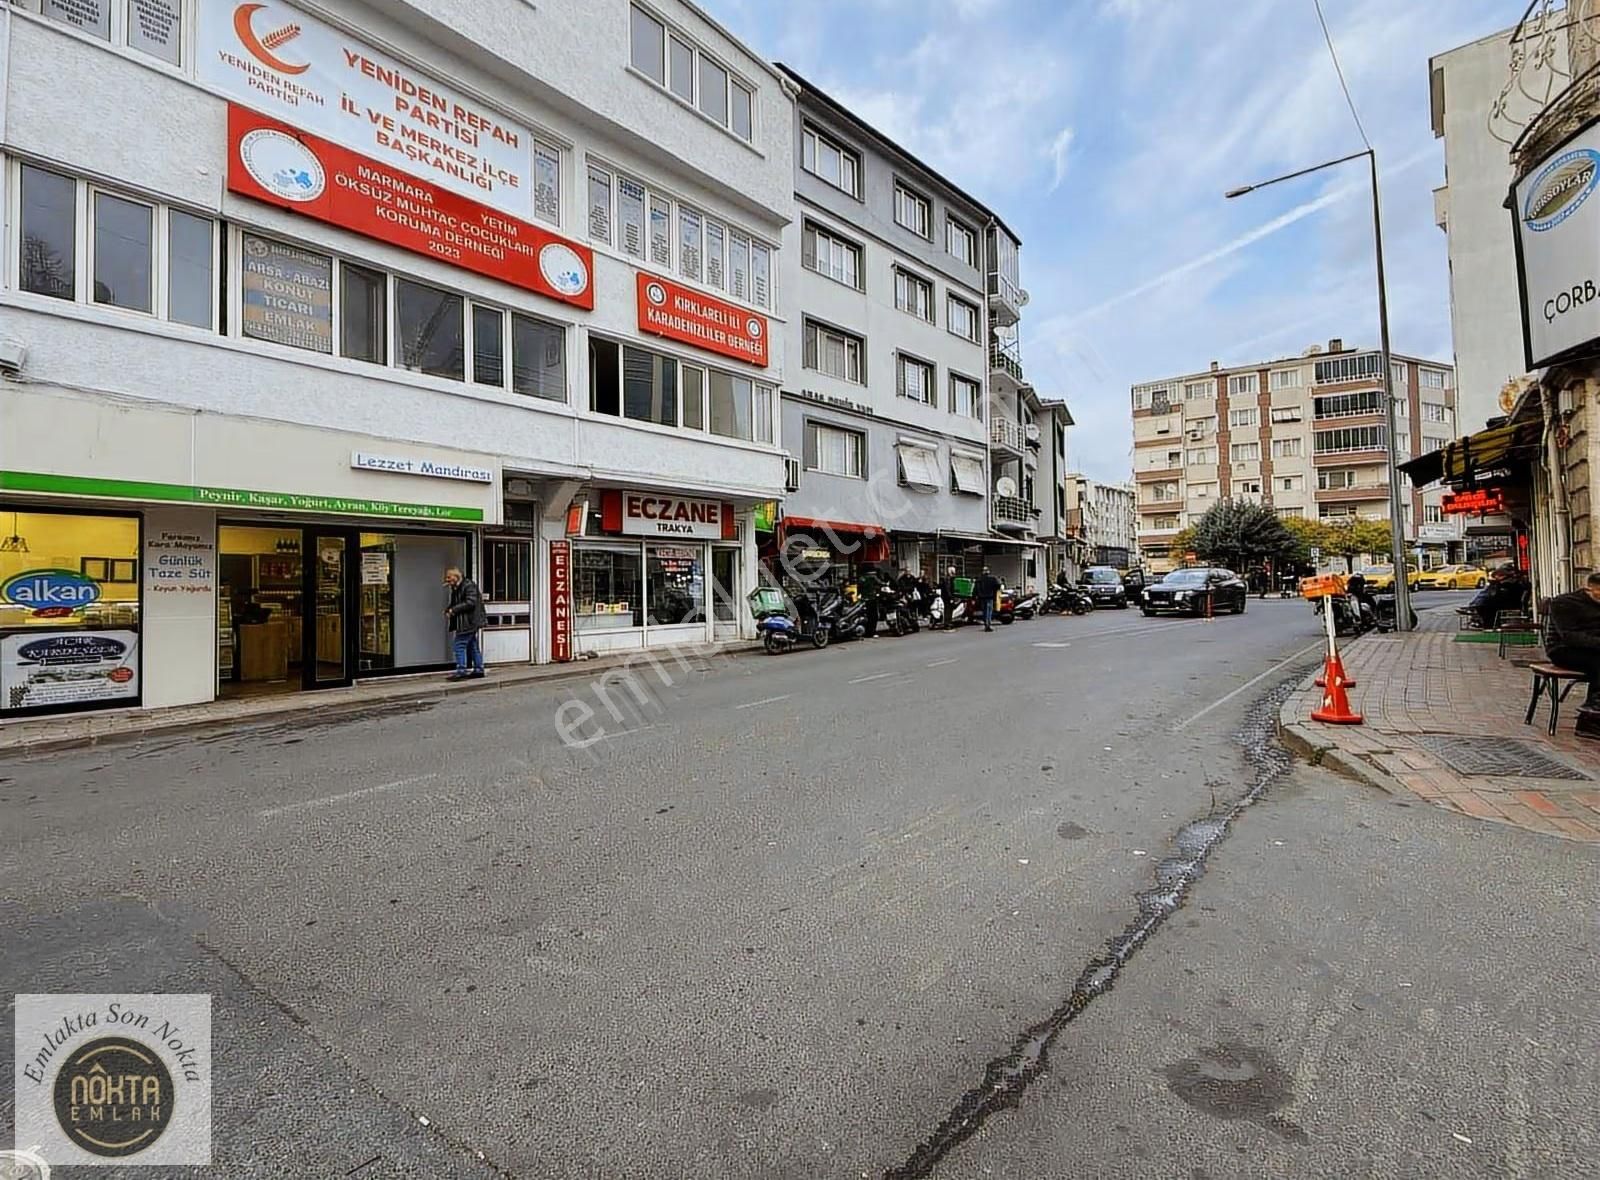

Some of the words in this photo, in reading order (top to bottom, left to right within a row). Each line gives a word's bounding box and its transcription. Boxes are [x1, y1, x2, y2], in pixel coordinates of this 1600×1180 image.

[218, 50, 280, 85] YENİDEN
[283, 79, 325, 106] REFAH
[248, 77, 298, 106] PARTİSİ
[343, 47, 447, 113] YENİDEN
[453, 104, 518, 149] REFAH
[395, 96, 478, 148] PARTİSİ
[341, 92, 360, 117] İL
[366, 108, 395, 132] VE
[401, 124, 478, 169] MERKEZ
[483, 158, 519, 188] İLÇE
[376, 131, 492, 192] BAŞKANLIĞI
[335, 170, 393, 204] ÖKSÜZ
[358, 165, 434, 204] MARMARA
[481, 213, 518, 237] YETİM
[376, 205, 442, 237] KORUMA
[428, 240, 461, 260] 2023
[248, 261, 282, 277] ARSA
[264, 279, 313, 299] KONUT
[1544, 280, 1600, 324] ÇORB
[674, 295, 728, 325] KIRKLARELİ
[729, 311, 740, 329] İLİ
[647, 307, 726, 345] KARADENİZLİLER
[727, 333, 763, 357] DERNEĞİ
[357, 453, 413, 471] Lezzet
[421, 462, 491, 480] Mandırası
[200, 489, 246, 503] Peynir,
[249, 492, 288, 506] Kaşar,
[290, 496, 332, 509] Yoğurt,
[334, 500, 368, 512] Ayran,
[627, 495, 718, 524] ECZANE
[657, 523, 693, 533] TRAKYA
[148, 567, 182, 578] Taze
[188, 568, 211, 578] Süt
[159, 554, 203, 566] Günlük
[16, 579, 96, 601] alkan
[555, 555, 567, 657] ECZANESİ
